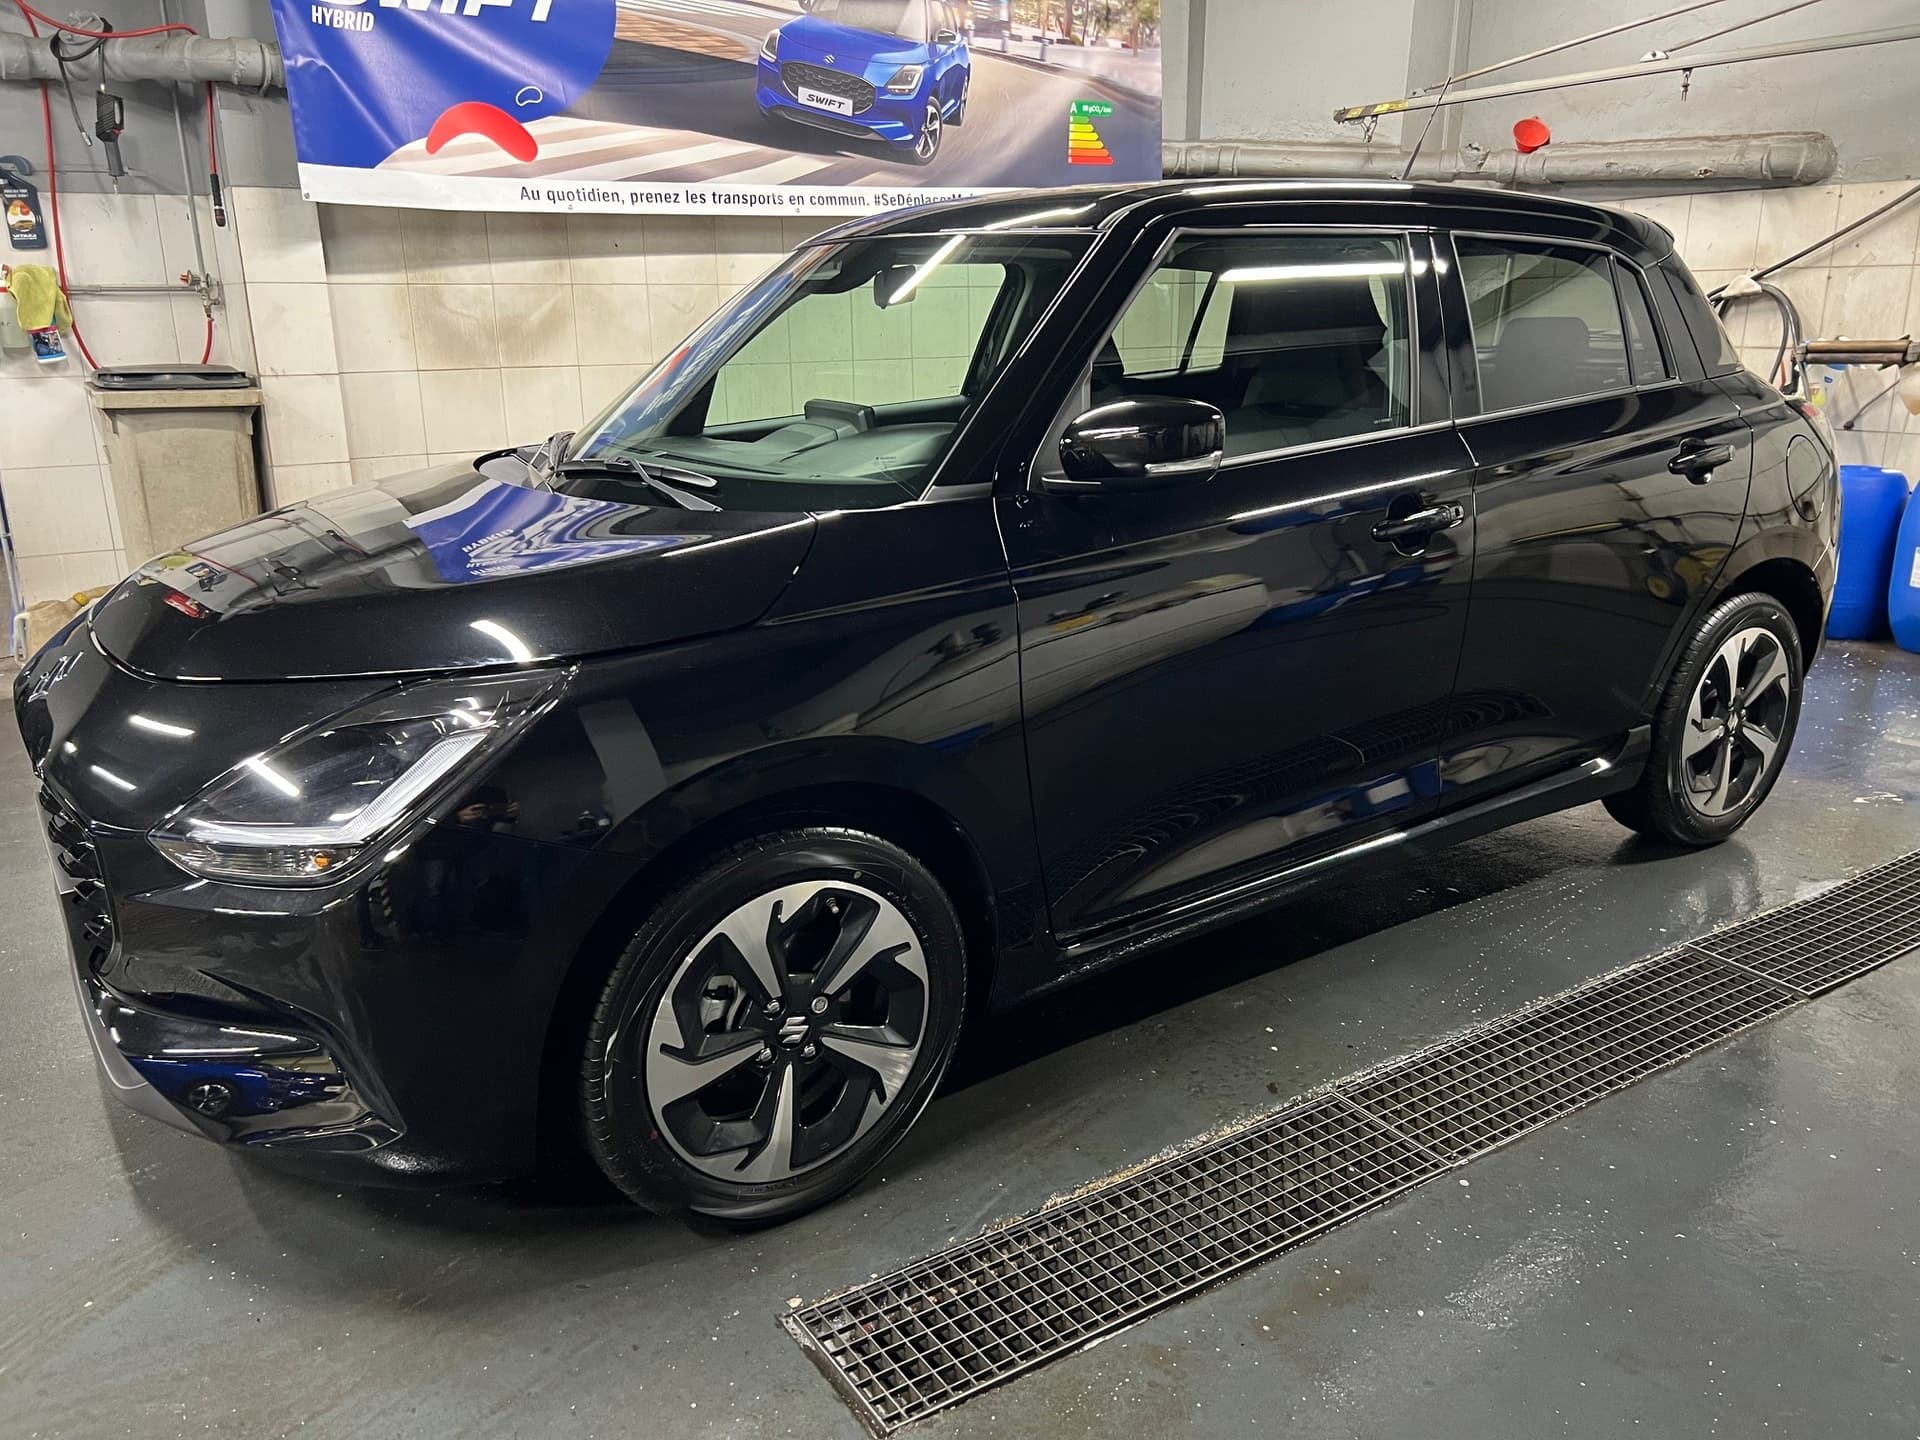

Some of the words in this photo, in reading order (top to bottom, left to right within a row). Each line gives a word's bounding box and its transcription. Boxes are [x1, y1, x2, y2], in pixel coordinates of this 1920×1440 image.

[311, 5, 375, 32] HYBRID
[806, 93, 845, 109] SWIFT
[1070, 101, 1078, 114] A
[520, 186, 541, 201] Au
[546, 187, 625, 205] quotidien,
[630, 191, 680, 206] prenez
[685, 189, 707, 204] les
[711, 191, 784, 208] transports
[788, 195, 805, 206] en
[809, 195, 870, 206] commun.
[874, 193, 975, 208] #SeDéplac
